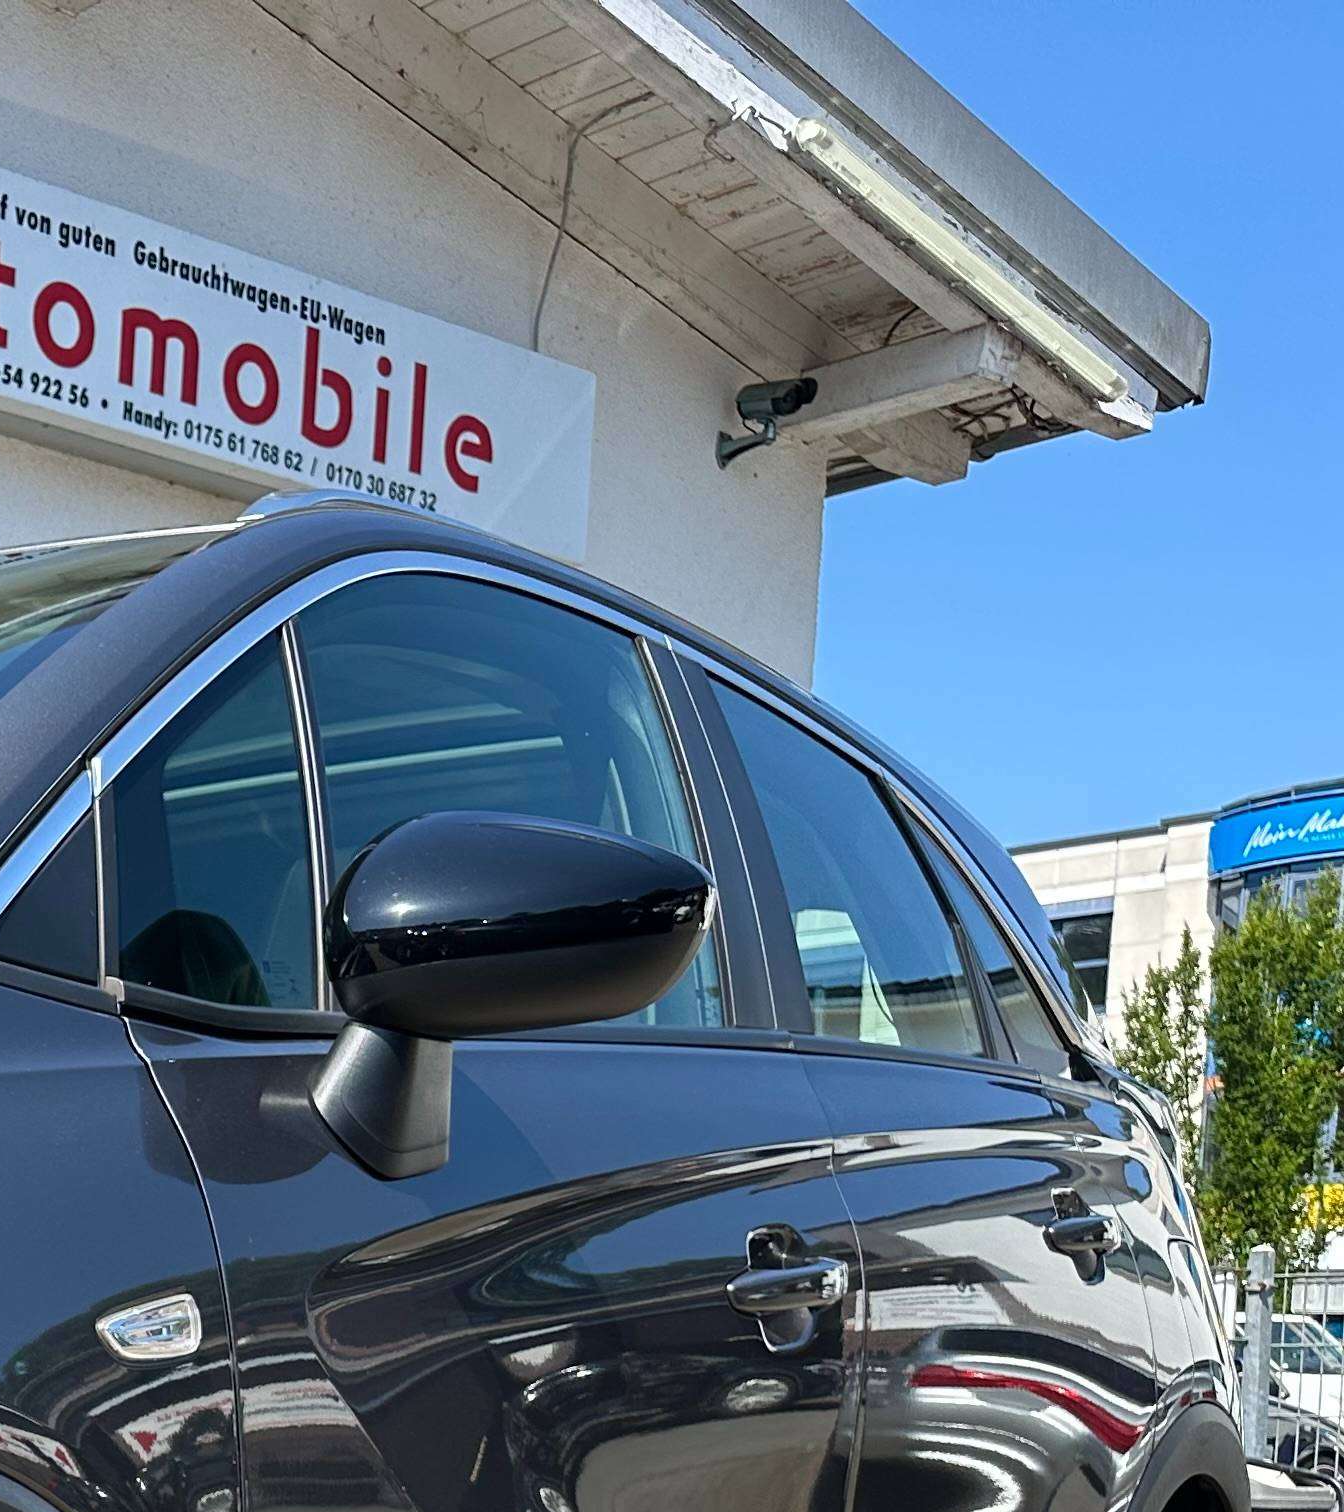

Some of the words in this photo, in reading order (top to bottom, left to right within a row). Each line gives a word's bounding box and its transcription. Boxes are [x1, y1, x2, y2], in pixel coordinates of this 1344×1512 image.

[15, 205, 52, 235] von
[59, 221, 116, 257] guten
[30, 372, 63, 401] 922
[68, 384, 90, 409] 56
[122, 399, 179, 440] Handy:
[183, 419, 223, 449] 0175
[227, 436, 246, 456] 61
[252, 439, 280, 466] 768
[284, 450, 303, 472] 62
[325, 462, 362, 490] 0170
[366, 474, 385, 497] 30
[388, 482, 416, 505] 687
[419, 492, 438, 512] 32
[1297, 808, 1344, 841] Ma
